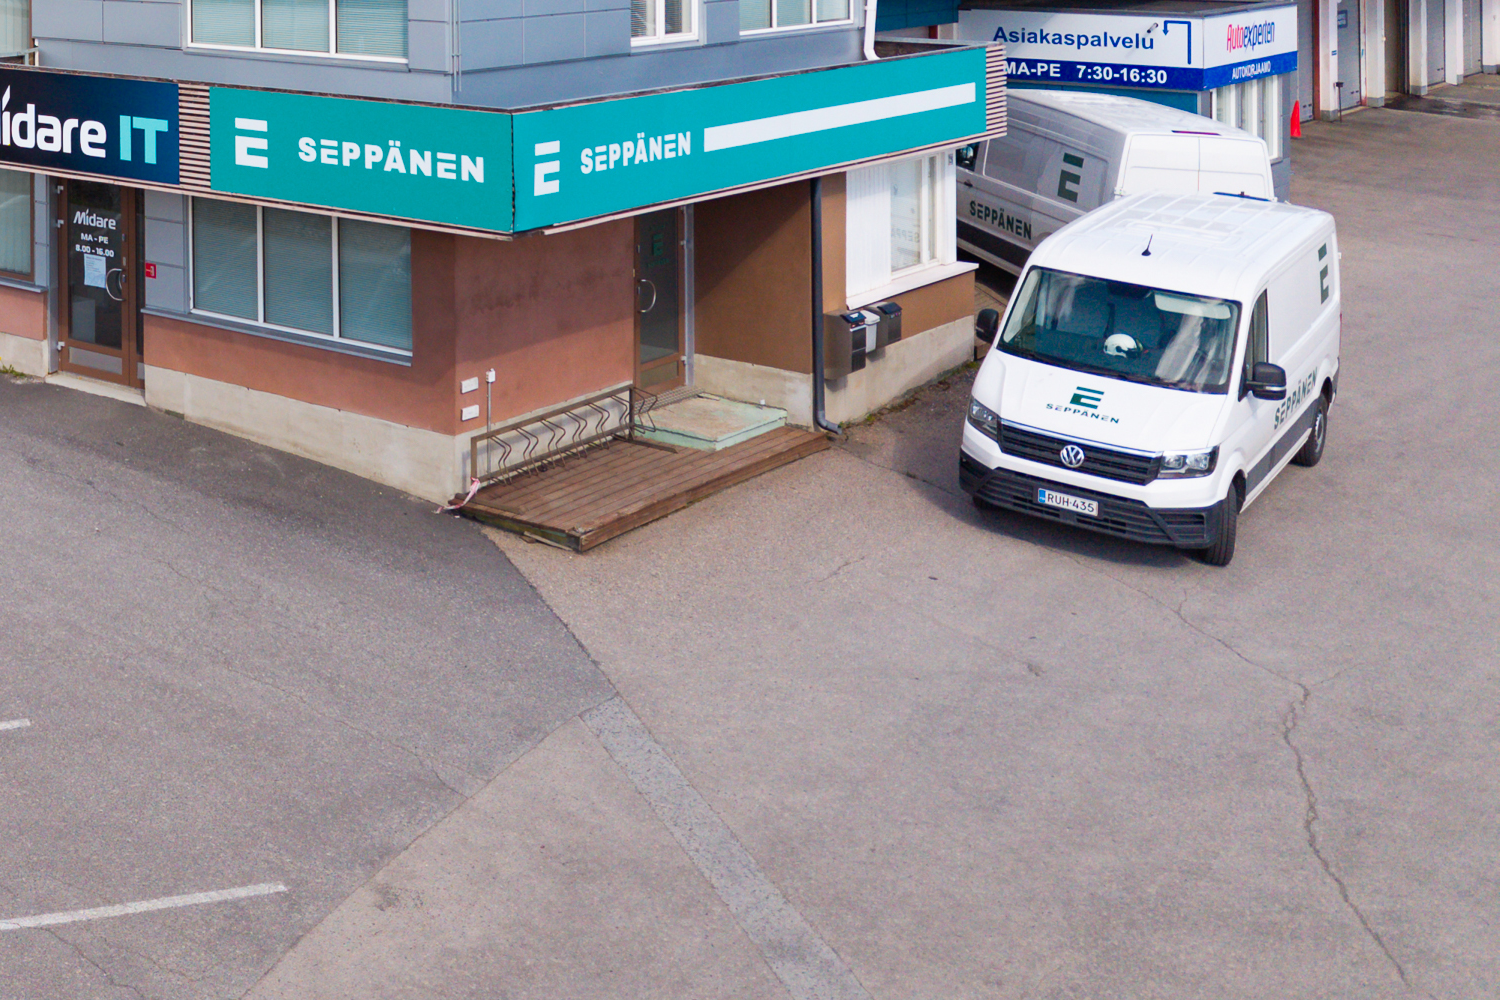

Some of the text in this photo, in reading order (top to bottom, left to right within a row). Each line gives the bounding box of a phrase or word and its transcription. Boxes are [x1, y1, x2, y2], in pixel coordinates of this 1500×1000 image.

[993, 26, 1154, 50] Asiakaspalvelu
[1226, 21, 1276, 53] Autoexperten
[1003, 60, 1168, 84] MA-PE 7:30-16:30
[119, 115, 169, 164] IT
[298, 136, 485, 184] SEPPÄNEN
[580, 131, 692, 175] SEPPÄNEN
[73, 208, 117, 230] Midare
[969, 200, 1032, 241] SEPPÄNEN
[75, 244, 91, 254] 8.00
[81, 233, 93, 242] MA
[99, 235, 109, 244] PE
[1274, 367, 1318, 430] SEPPÄNEN
[1046, 403, 1120, 424] SEPPÄNEN
[1047, 493, 1095, 513] RUH-435
